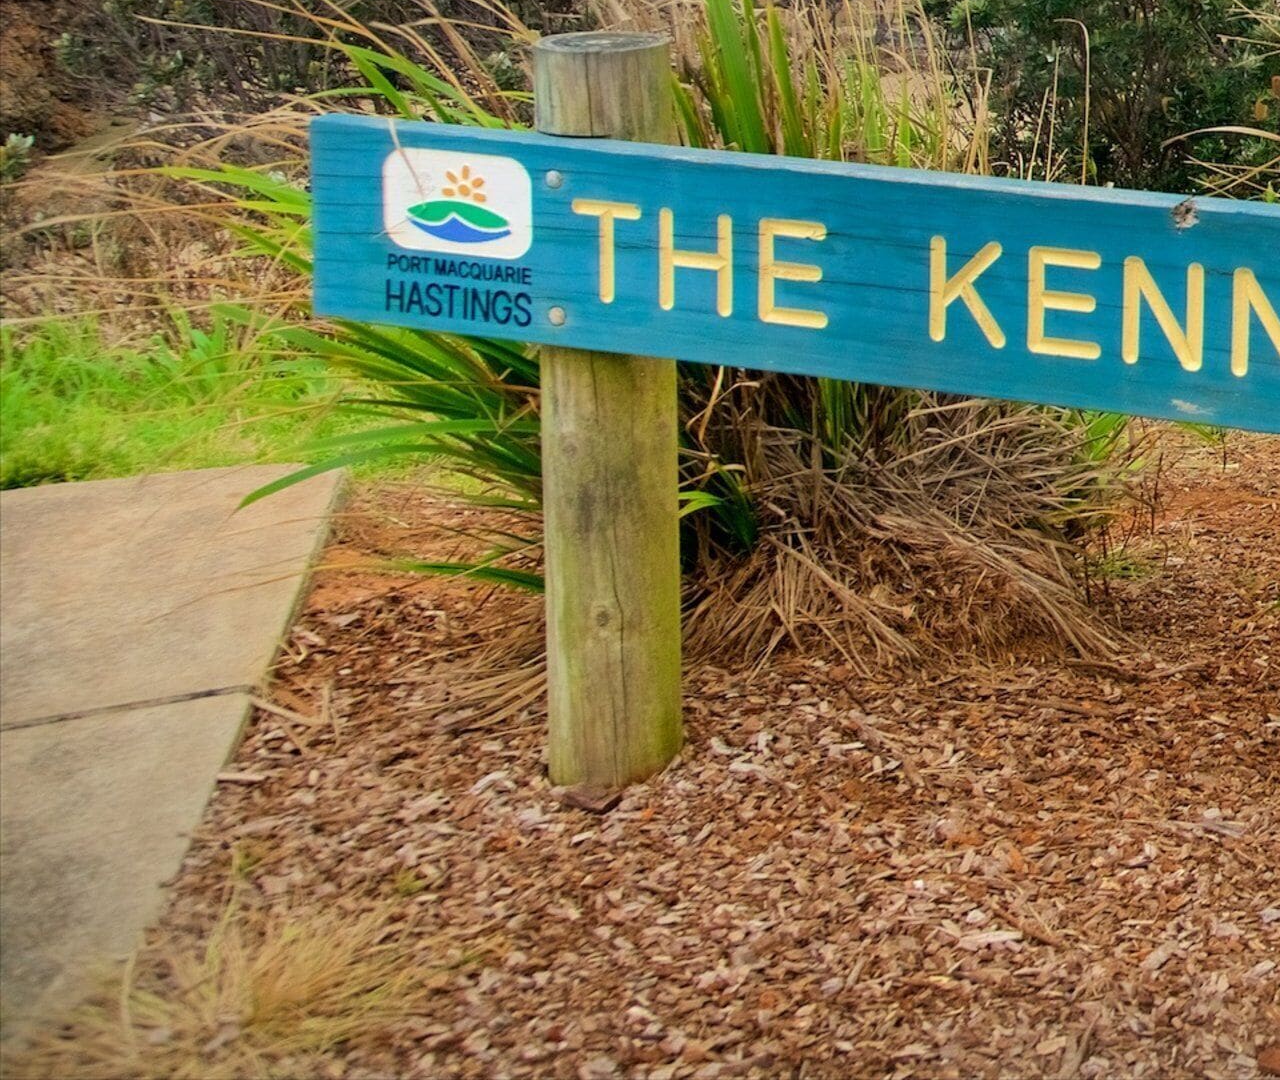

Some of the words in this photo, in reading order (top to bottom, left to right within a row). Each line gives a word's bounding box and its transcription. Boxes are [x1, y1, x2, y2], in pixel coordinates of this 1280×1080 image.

[387, 253, 433, 274] PORT
[434, 258, 533, 285] MACQUARIE
[571, 198, 829, 328] THE
[385, 278, 533, 327] HASTINGS
